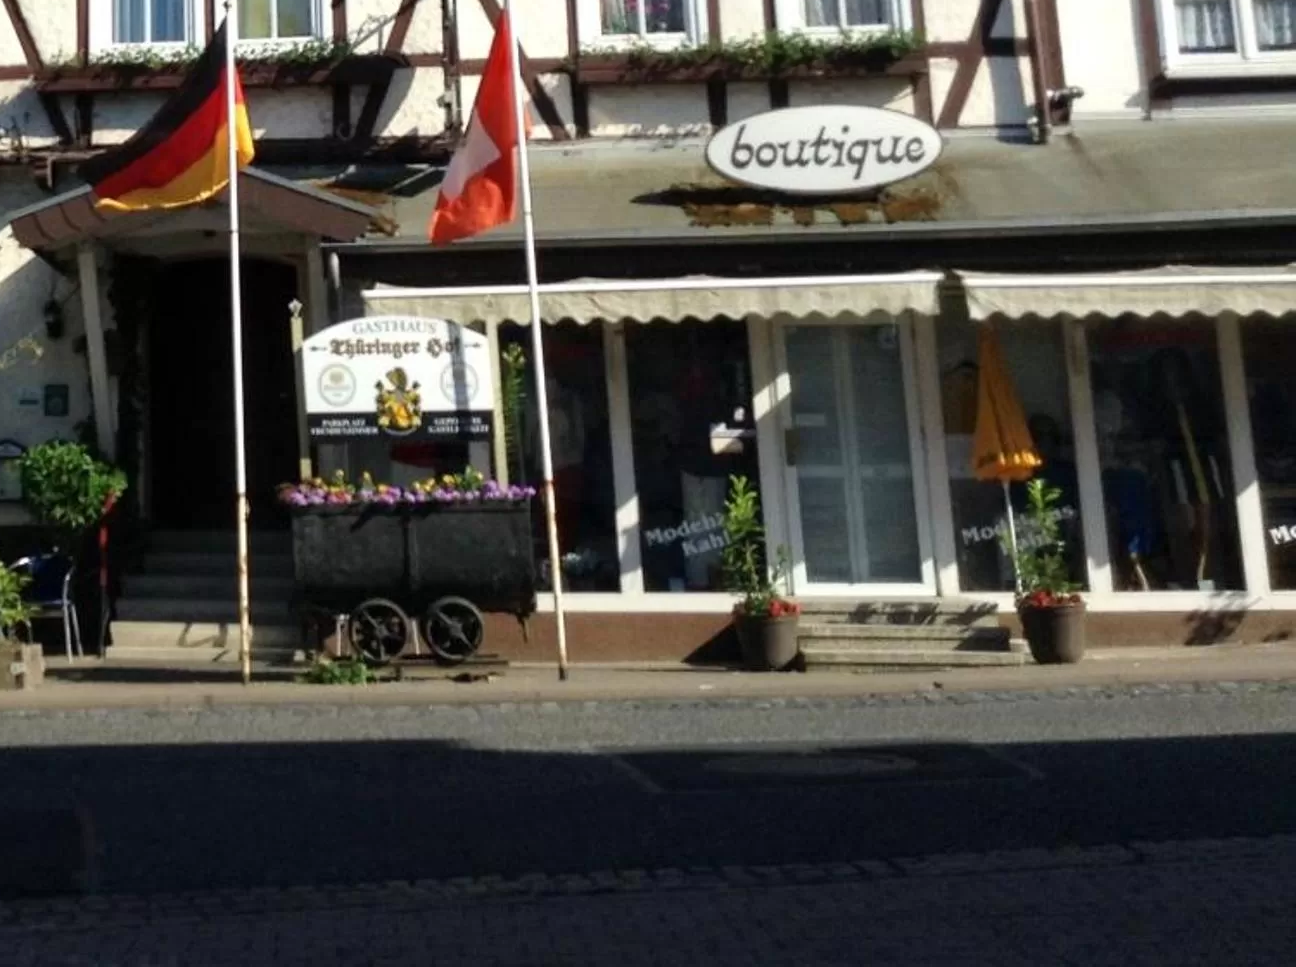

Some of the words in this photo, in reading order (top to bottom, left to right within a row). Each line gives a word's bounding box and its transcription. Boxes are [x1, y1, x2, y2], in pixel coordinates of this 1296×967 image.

[730, 124, 926, 180] boutique
[352, 320, 438, 335] GASTHAUS
[330, 337, 421, 359] Thüringer
[681, 529, 733, 557] Kahl
